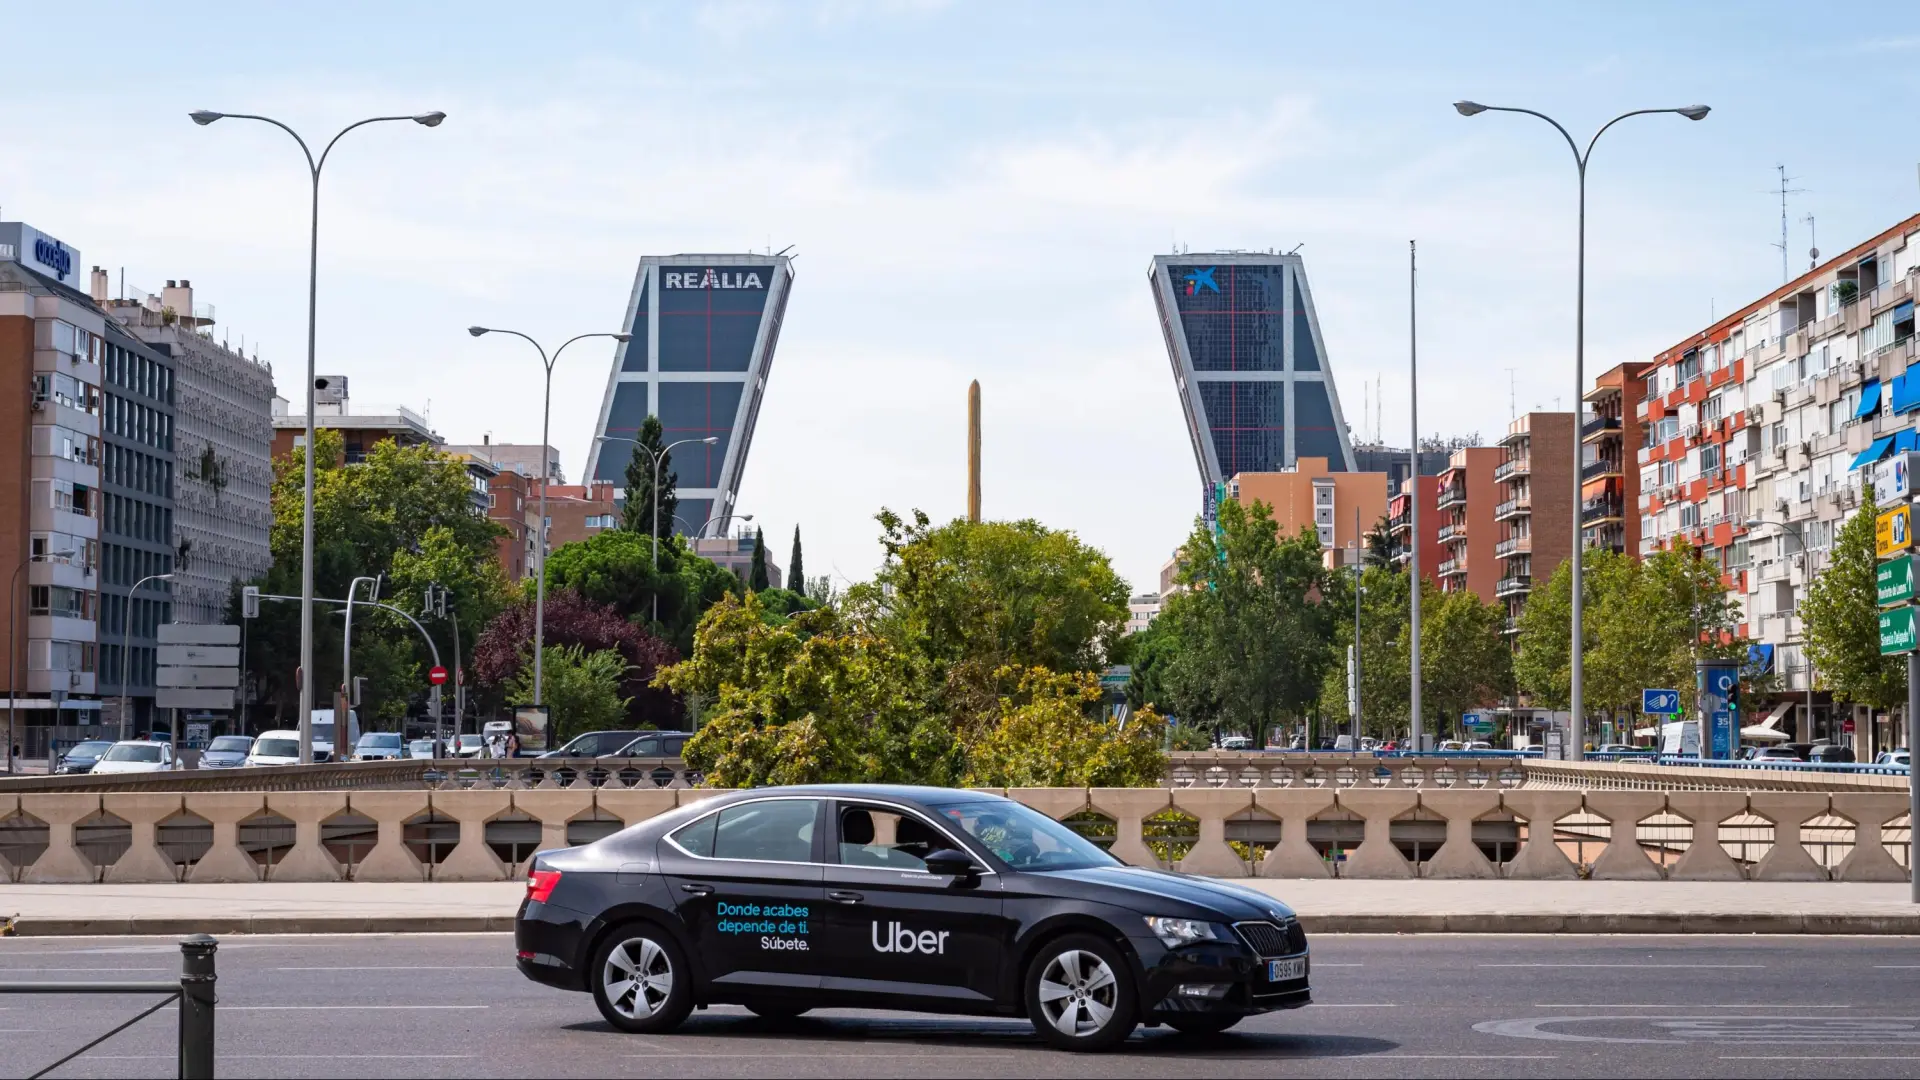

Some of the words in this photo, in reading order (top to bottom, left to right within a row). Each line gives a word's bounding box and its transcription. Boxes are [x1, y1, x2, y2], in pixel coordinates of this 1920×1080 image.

[665, 268, 764, 289] REALIA
[717, 901, 760, 917] Donde
[762, 903, 809, 918] acabes
[717, 918, 776, 936] depende
[778, 919, 796, 934] de
[798, 920, 809, 935] ti.
[761, 935, 810, 951] Súbete.
[872, 920, 950, 955] Uber
